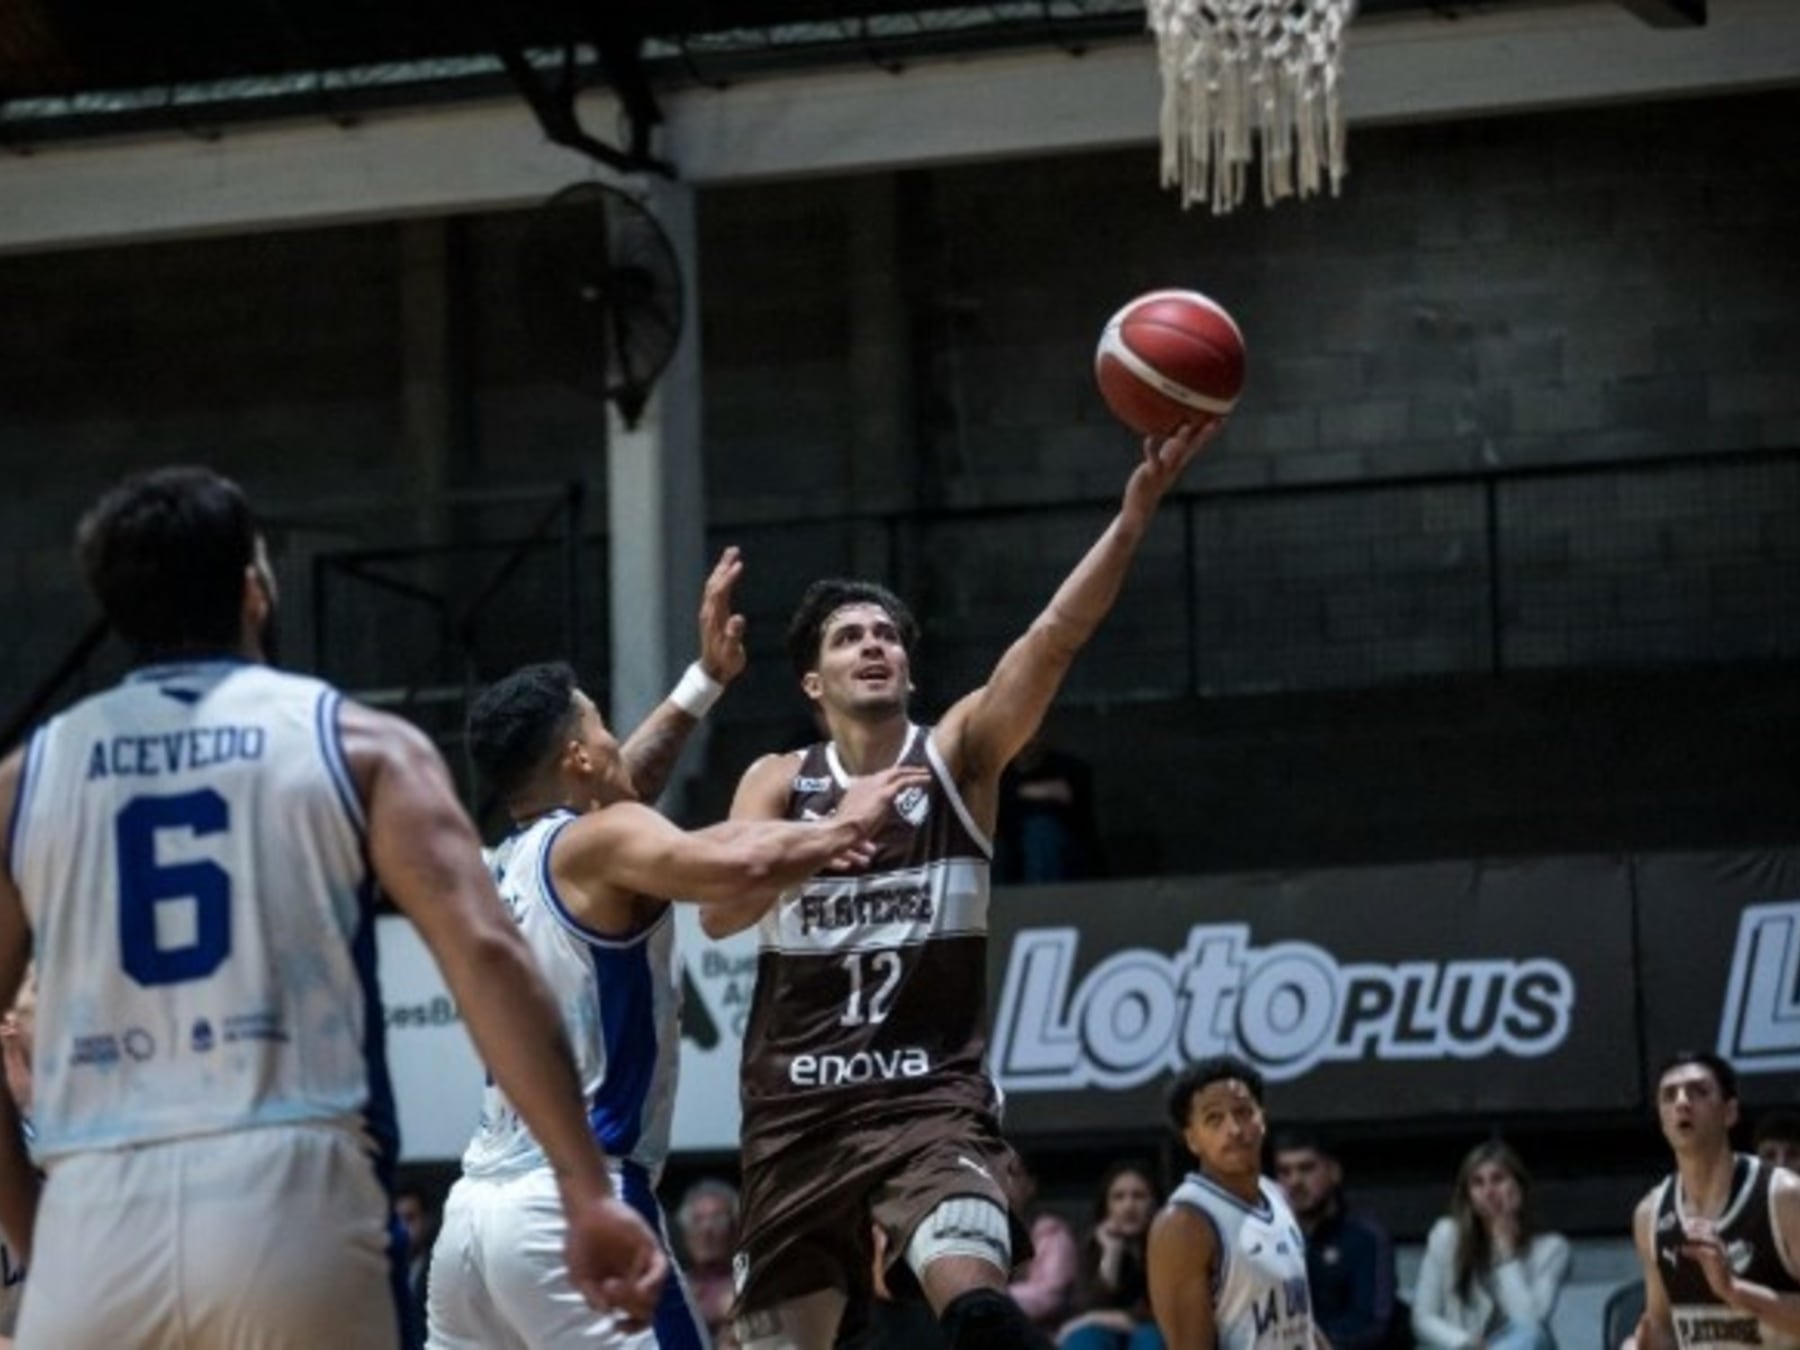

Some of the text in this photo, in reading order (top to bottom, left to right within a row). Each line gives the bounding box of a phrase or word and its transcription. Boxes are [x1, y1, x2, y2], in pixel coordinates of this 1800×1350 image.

[85, 725, 265, 781] ACEVEDO
[116, 786, 232, 988] 6
[839, 951, 902, 1027] 12
[789, 1047, 931, 1086] enova
